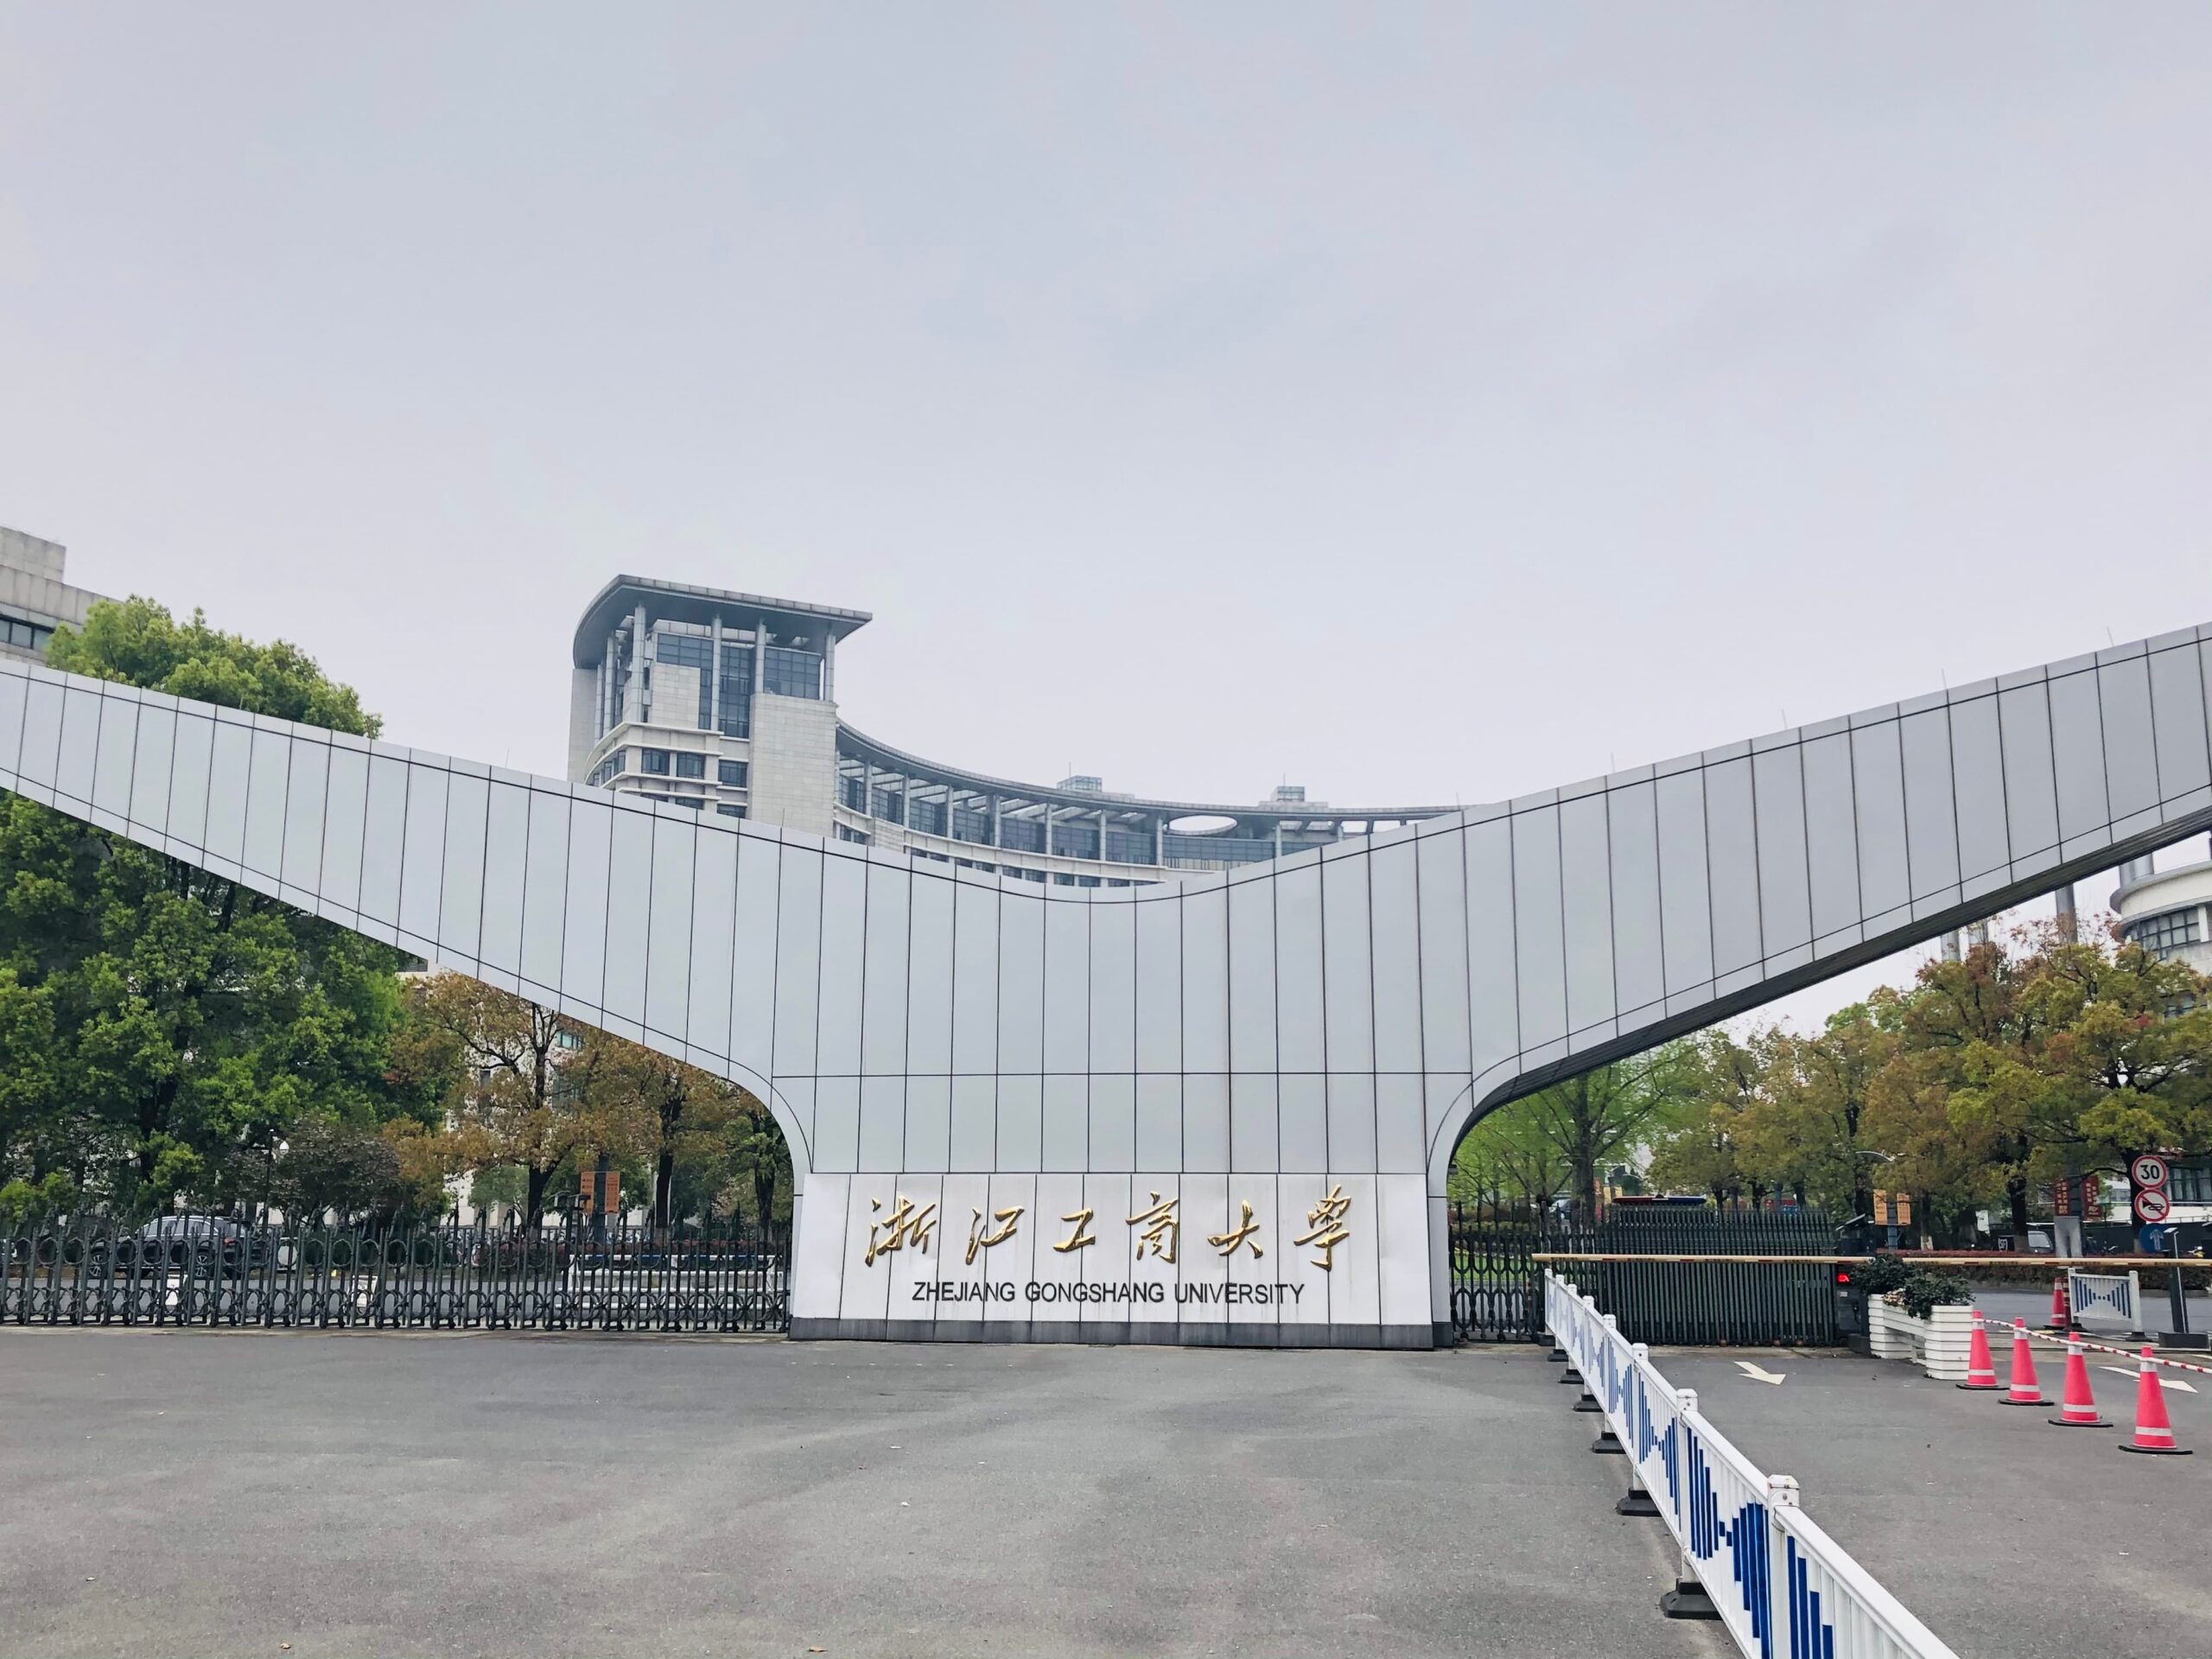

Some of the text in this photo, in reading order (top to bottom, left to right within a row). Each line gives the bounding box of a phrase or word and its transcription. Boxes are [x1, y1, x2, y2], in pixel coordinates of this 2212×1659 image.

[2140, 1164, 2160, 1180] 30
[912, 1281, 1305, 1304] ZHEJIANG GONGSHANG UNIVERSITY
